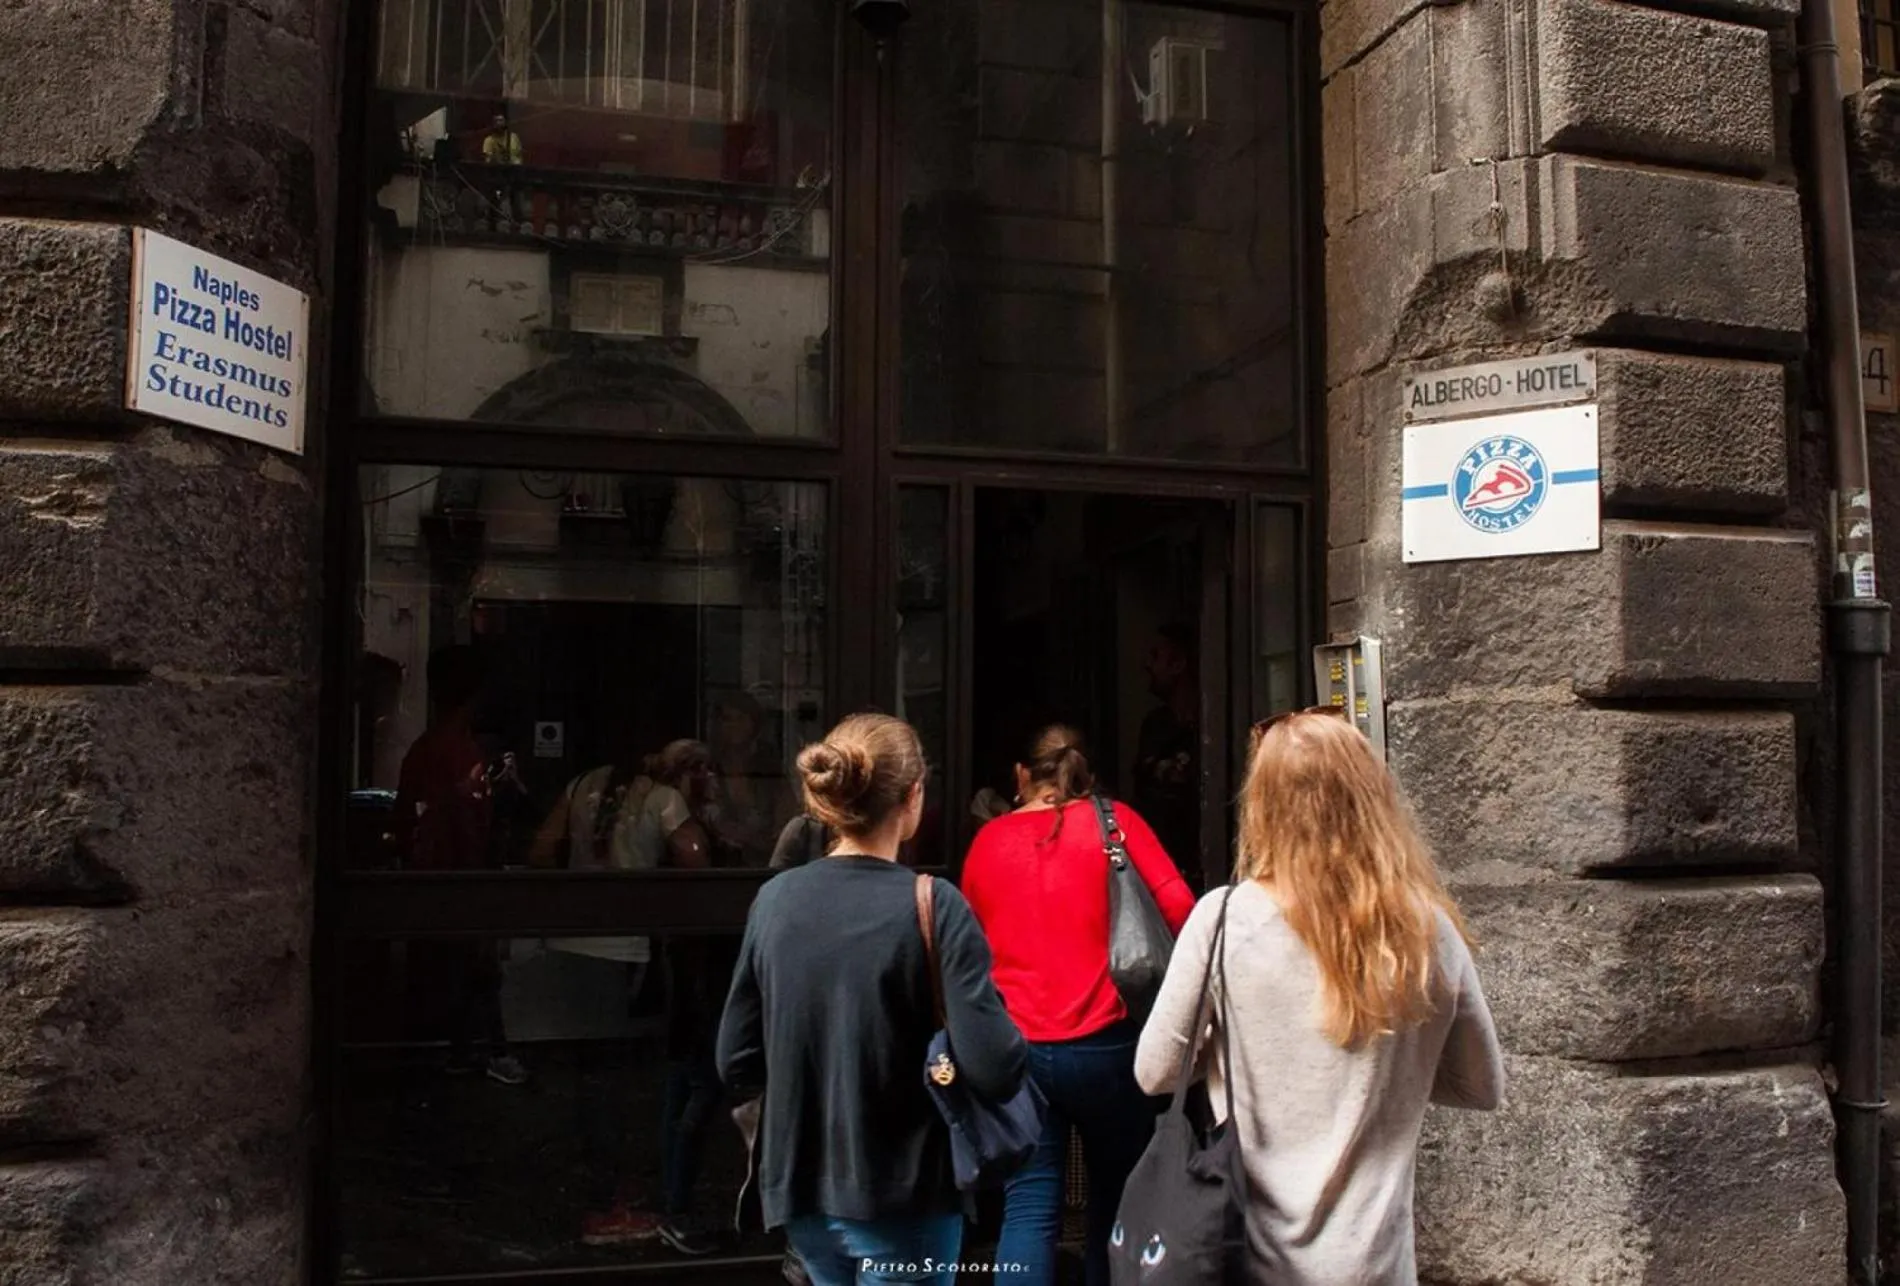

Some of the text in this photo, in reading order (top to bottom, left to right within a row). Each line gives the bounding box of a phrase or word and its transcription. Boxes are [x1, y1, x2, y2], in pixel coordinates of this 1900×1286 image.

[194, 265, 260, 310] Naples
[154, 282, 292, 361] Pizza Hostel
[154, 330, 291, 397] Erasmus
[1411, 364, 1588, 408] ALBERGO HOTEL
[147, 364, 287, 427] Students
[1462, 439, 1539, 474] PIZZA
[1466, 503, 1536, 529] HOSTEL
